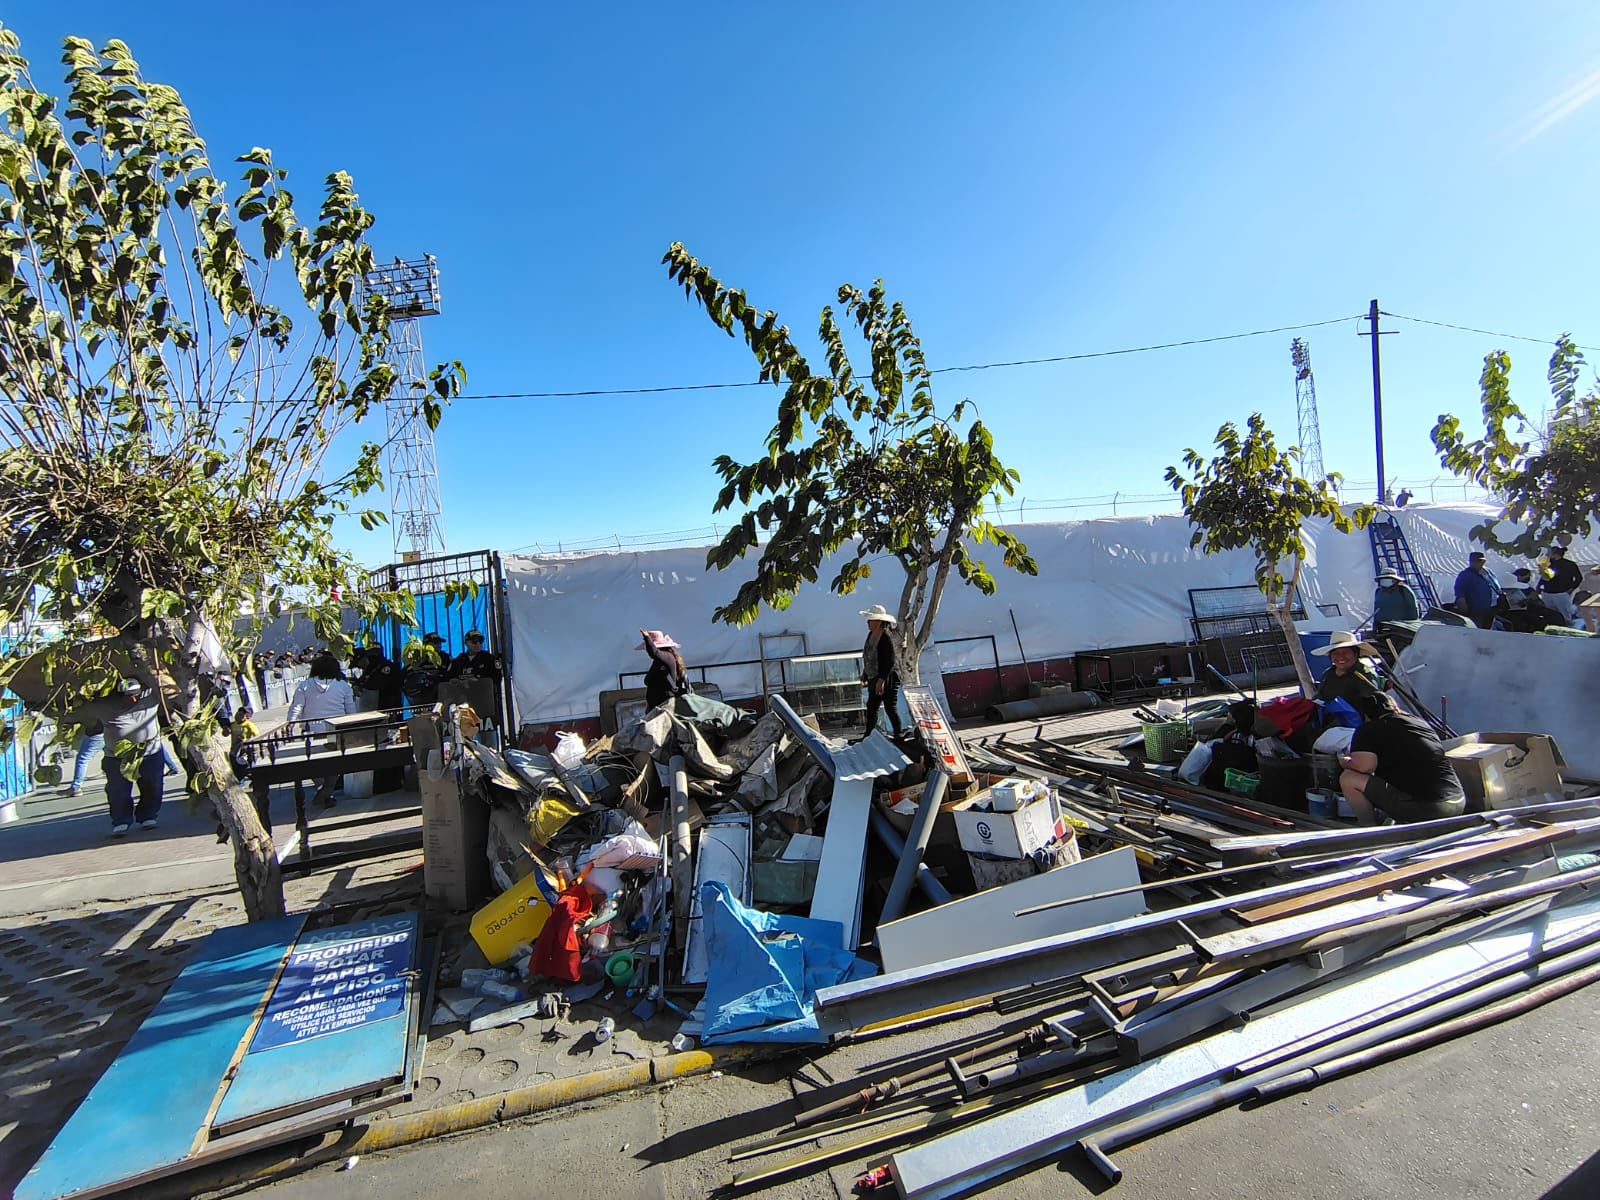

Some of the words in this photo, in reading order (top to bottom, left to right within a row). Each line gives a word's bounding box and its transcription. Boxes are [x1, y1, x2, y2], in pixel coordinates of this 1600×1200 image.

[442, 717, 494, 736] POIA
[487, 905, 526, 935] OXFORD
[294, 932, 409, 965] PROHIBIDO
[314, 949, 385, 972] BOTAR
[311, 962, 381, 986] PAPEL
[294, 988, 325, 1004] AL
[333, 973, 386, 995] PISO
[272, 983, 400, 1022] RECOMENDACIONES
[315, 1008, 335, 1020] AGUA
[336, 1003, 356, 1013] CADA
[358, 999, 371, 1008] VEZ
[373, 996, 387, 1004] QUE
[290, 1019, 320, 1031] UTILICE
[321, 1014, 335, 1024] LOS
[338, 1005, 376, 1020] SERVICIOS
[296, 1027, 318, 1038] ATTE:
[320, 1024, 330, 1032] LA
[331, 1015, 366, 1029] EMPRESA
